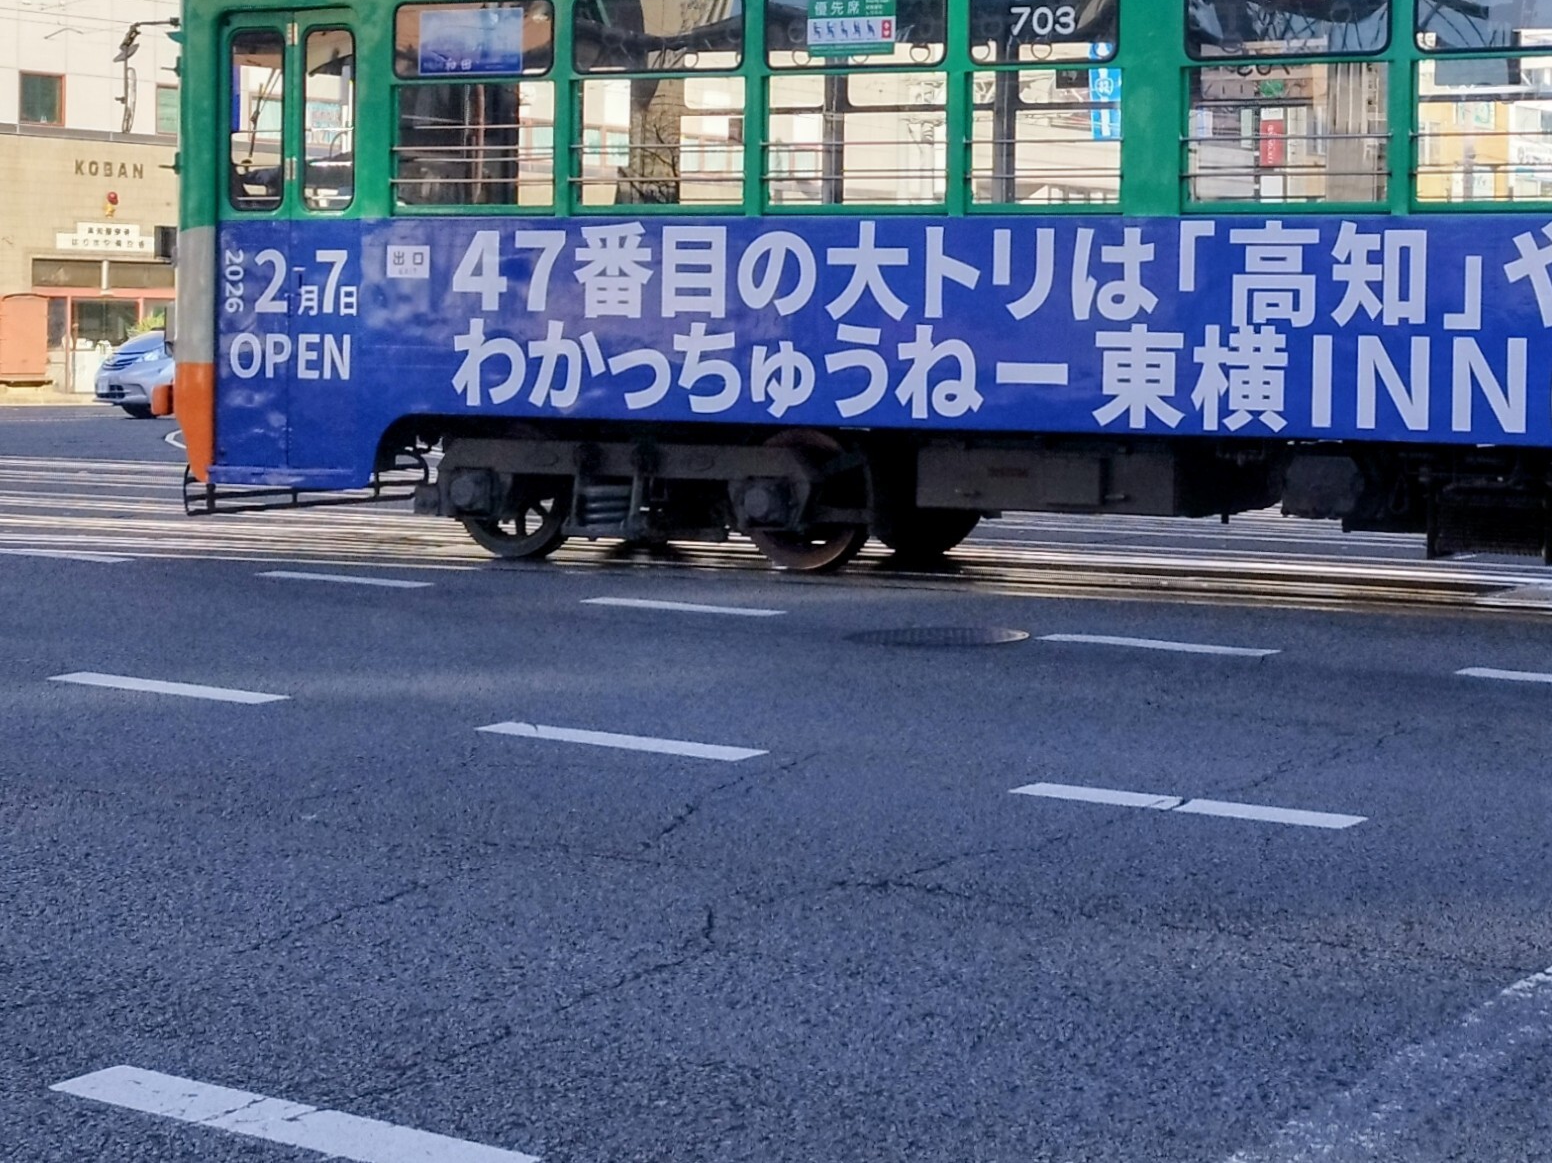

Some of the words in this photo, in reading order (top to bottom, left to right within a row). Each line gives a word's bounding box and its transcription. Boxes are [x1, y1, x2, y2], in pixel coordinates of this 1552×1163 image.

[814, 0, 860, 16] 優先席
[1010, 5, 1076, 36] 703
[75, 159, 144, 180] KOBAN
[393, 251, 424, 266] 出口
[225, 249, 244, 314] 2026
[230, 332, 352, 381] OPEN
